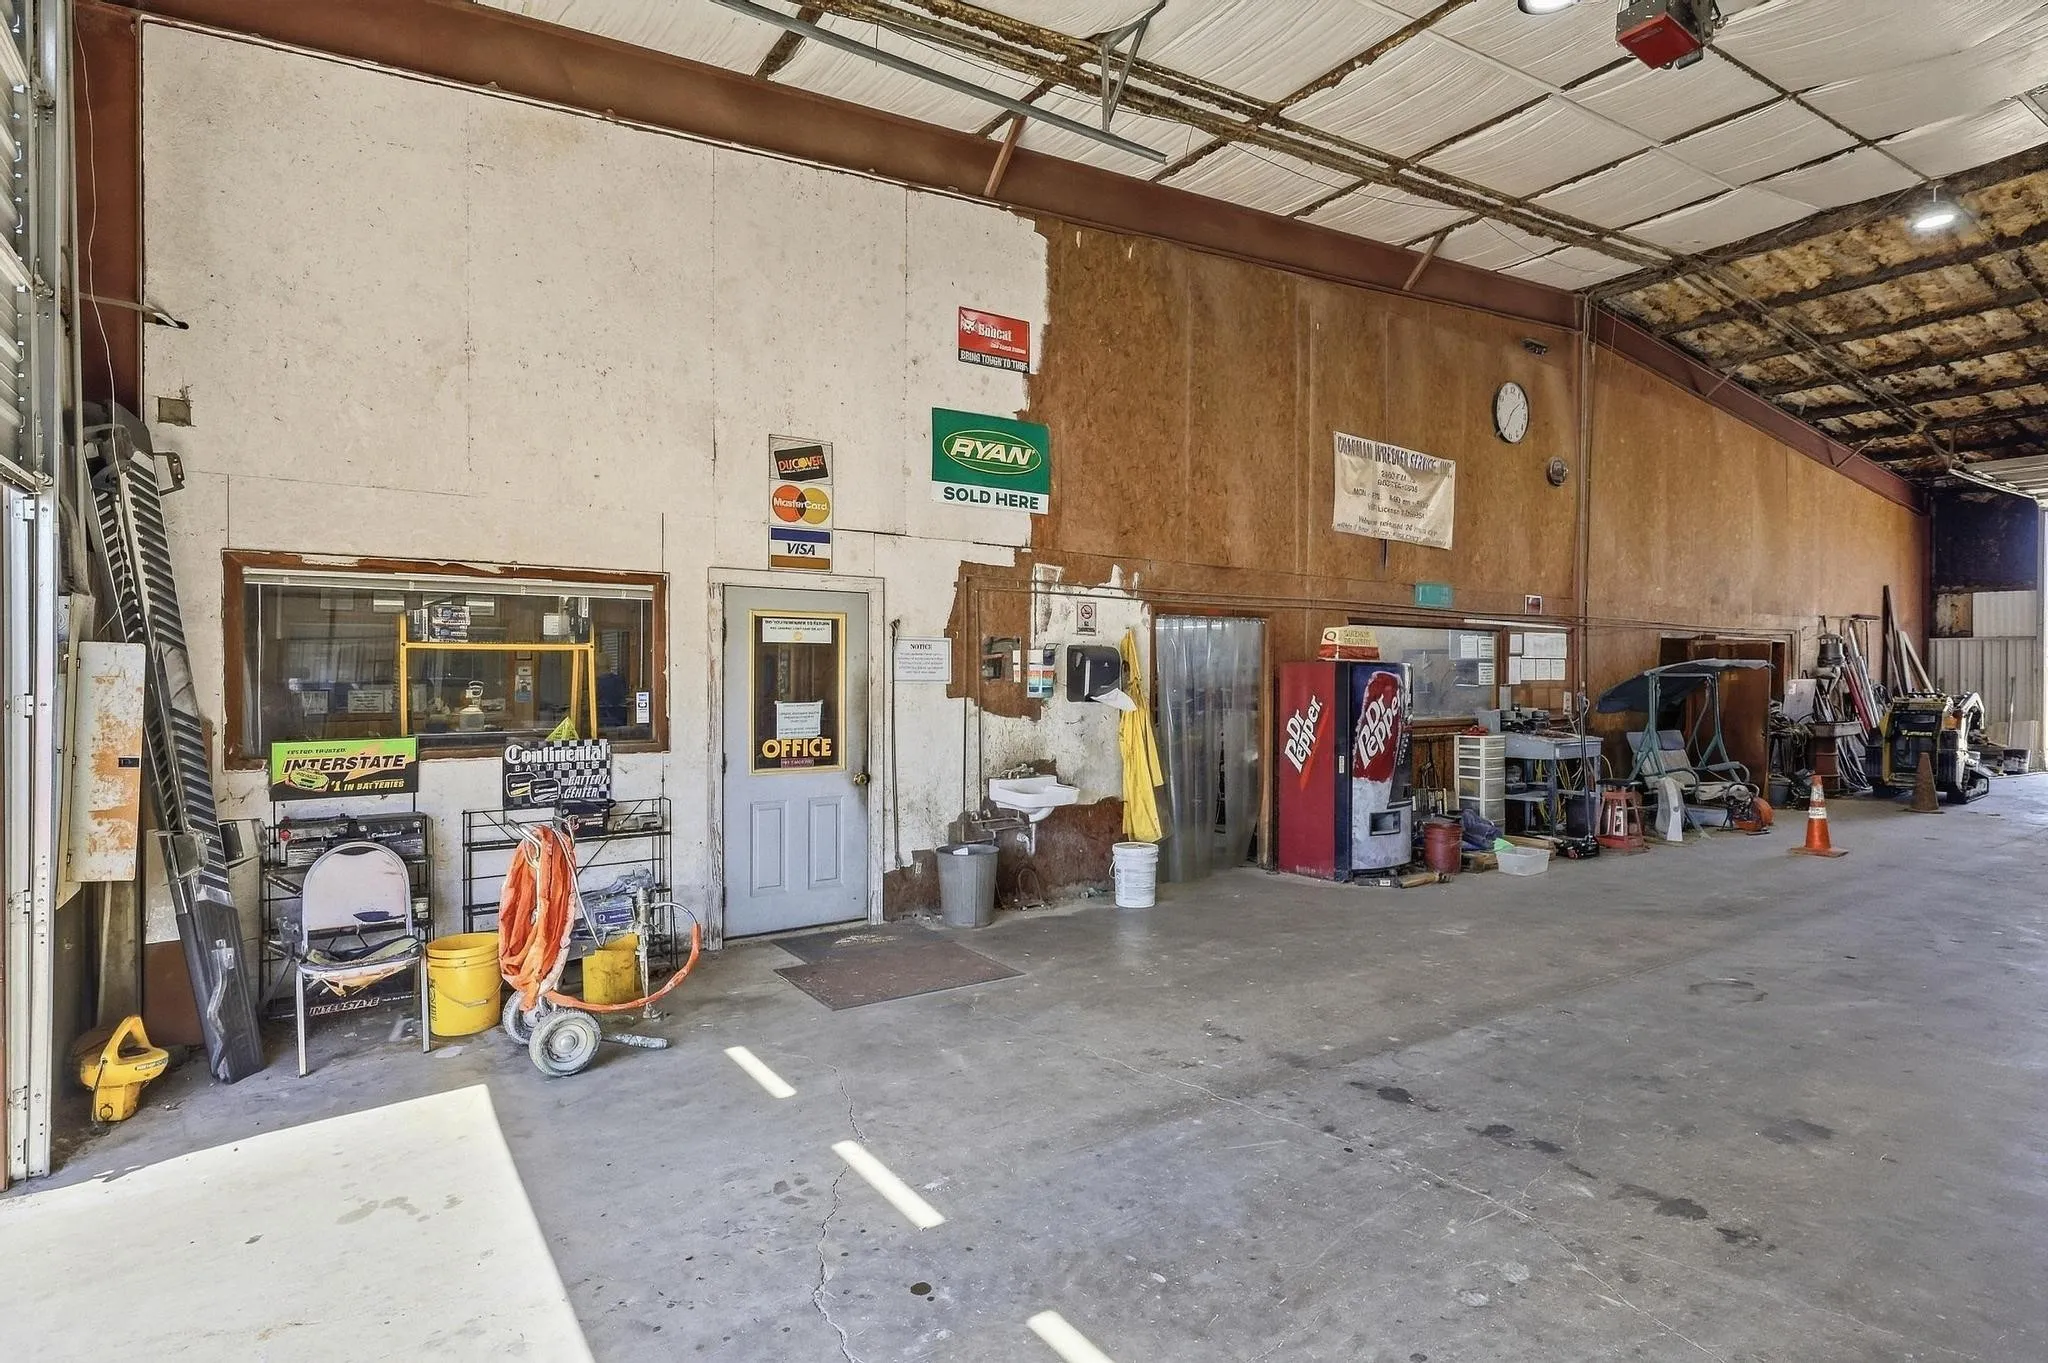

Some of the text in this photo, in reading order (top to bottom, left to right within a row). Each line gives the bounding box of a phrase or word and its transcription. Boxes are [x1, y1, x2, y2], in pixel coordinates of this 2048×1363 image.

[978, 323, 1012, 342] Bobcat
[960, 350, 981, 363] BRING
[981, 354, 1002, 367] TOUGH
[1002, 357, 1011, 369] TO
[950, 437, 1033, 466] RYAN
[777, 454, 824, 472] DISCOVER
[773, 496, 828, 511] MasterCard
[943, 486, 1039, 510] SOLD HERE
[787, 542, 816, 556] VISA
[1366, 693, 1386, 733] Dr
[1284, 695, 1321, 773] Pepper
[1286, 709, 1305, 742] Dr
[504, 741, 607, 764] Continental
[762, 738, 832, 758] OFFICE
[283, 754, 406, 773] INTERSTATE
[515, 762, 600, 771] BATTERIES
[344, 783, 354, 791] IN
[356, 780, 405, 790] BATTERIES
[568, 774, 607, 786] BATTERY
[564, 787, 599, 799] CENTER
